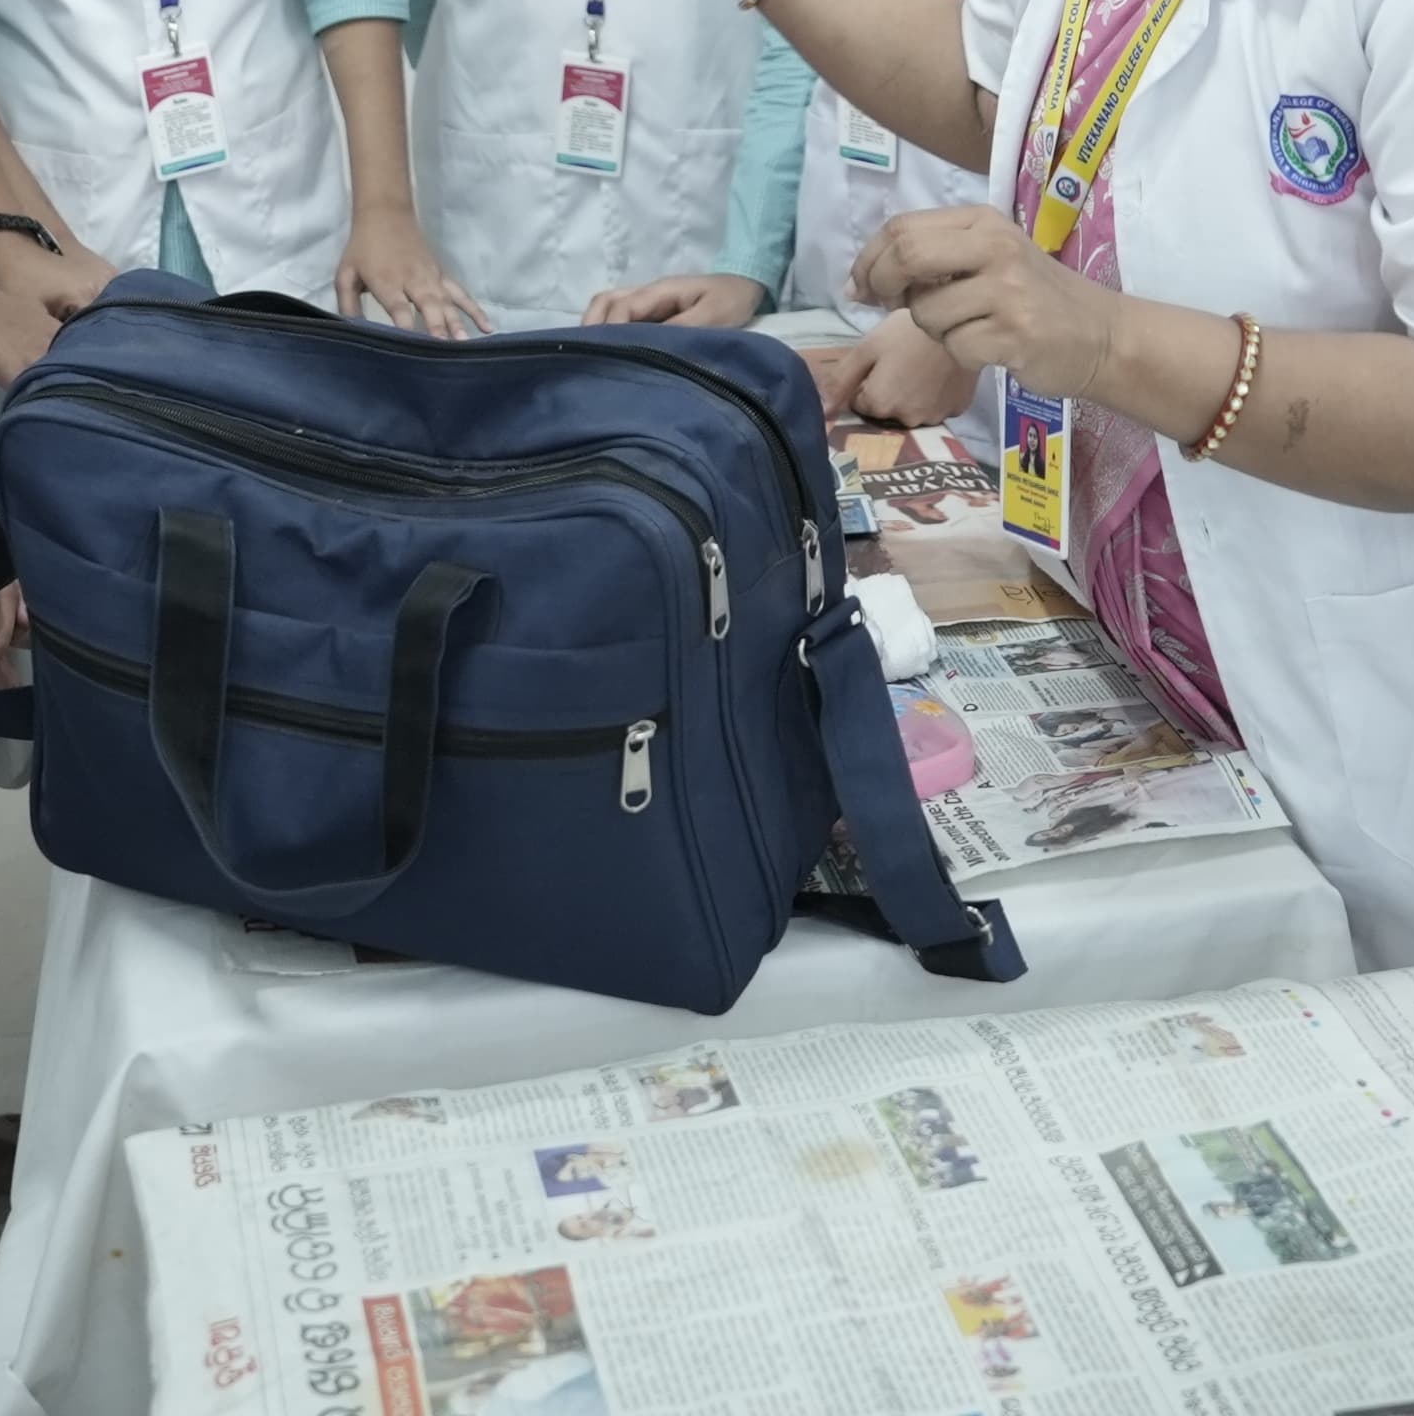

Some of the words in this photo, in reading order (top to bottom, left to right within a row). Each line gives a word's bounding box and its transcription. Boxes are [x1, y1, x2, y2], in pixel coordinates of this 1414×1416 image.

[1050, 28, 1073, 110] VIVEKANAND
[1077, 92, 1119, 164] VIVEKANAND
[1115, 43, 1144, 93] COLLEGE
[1142, 26, 1154, 44] OF
[953, 806, 974, 821] the
[942, 825, 969, 845] come
[966, 820, 1003, 852] meeting
[955, 843, 987, 868] Wish
